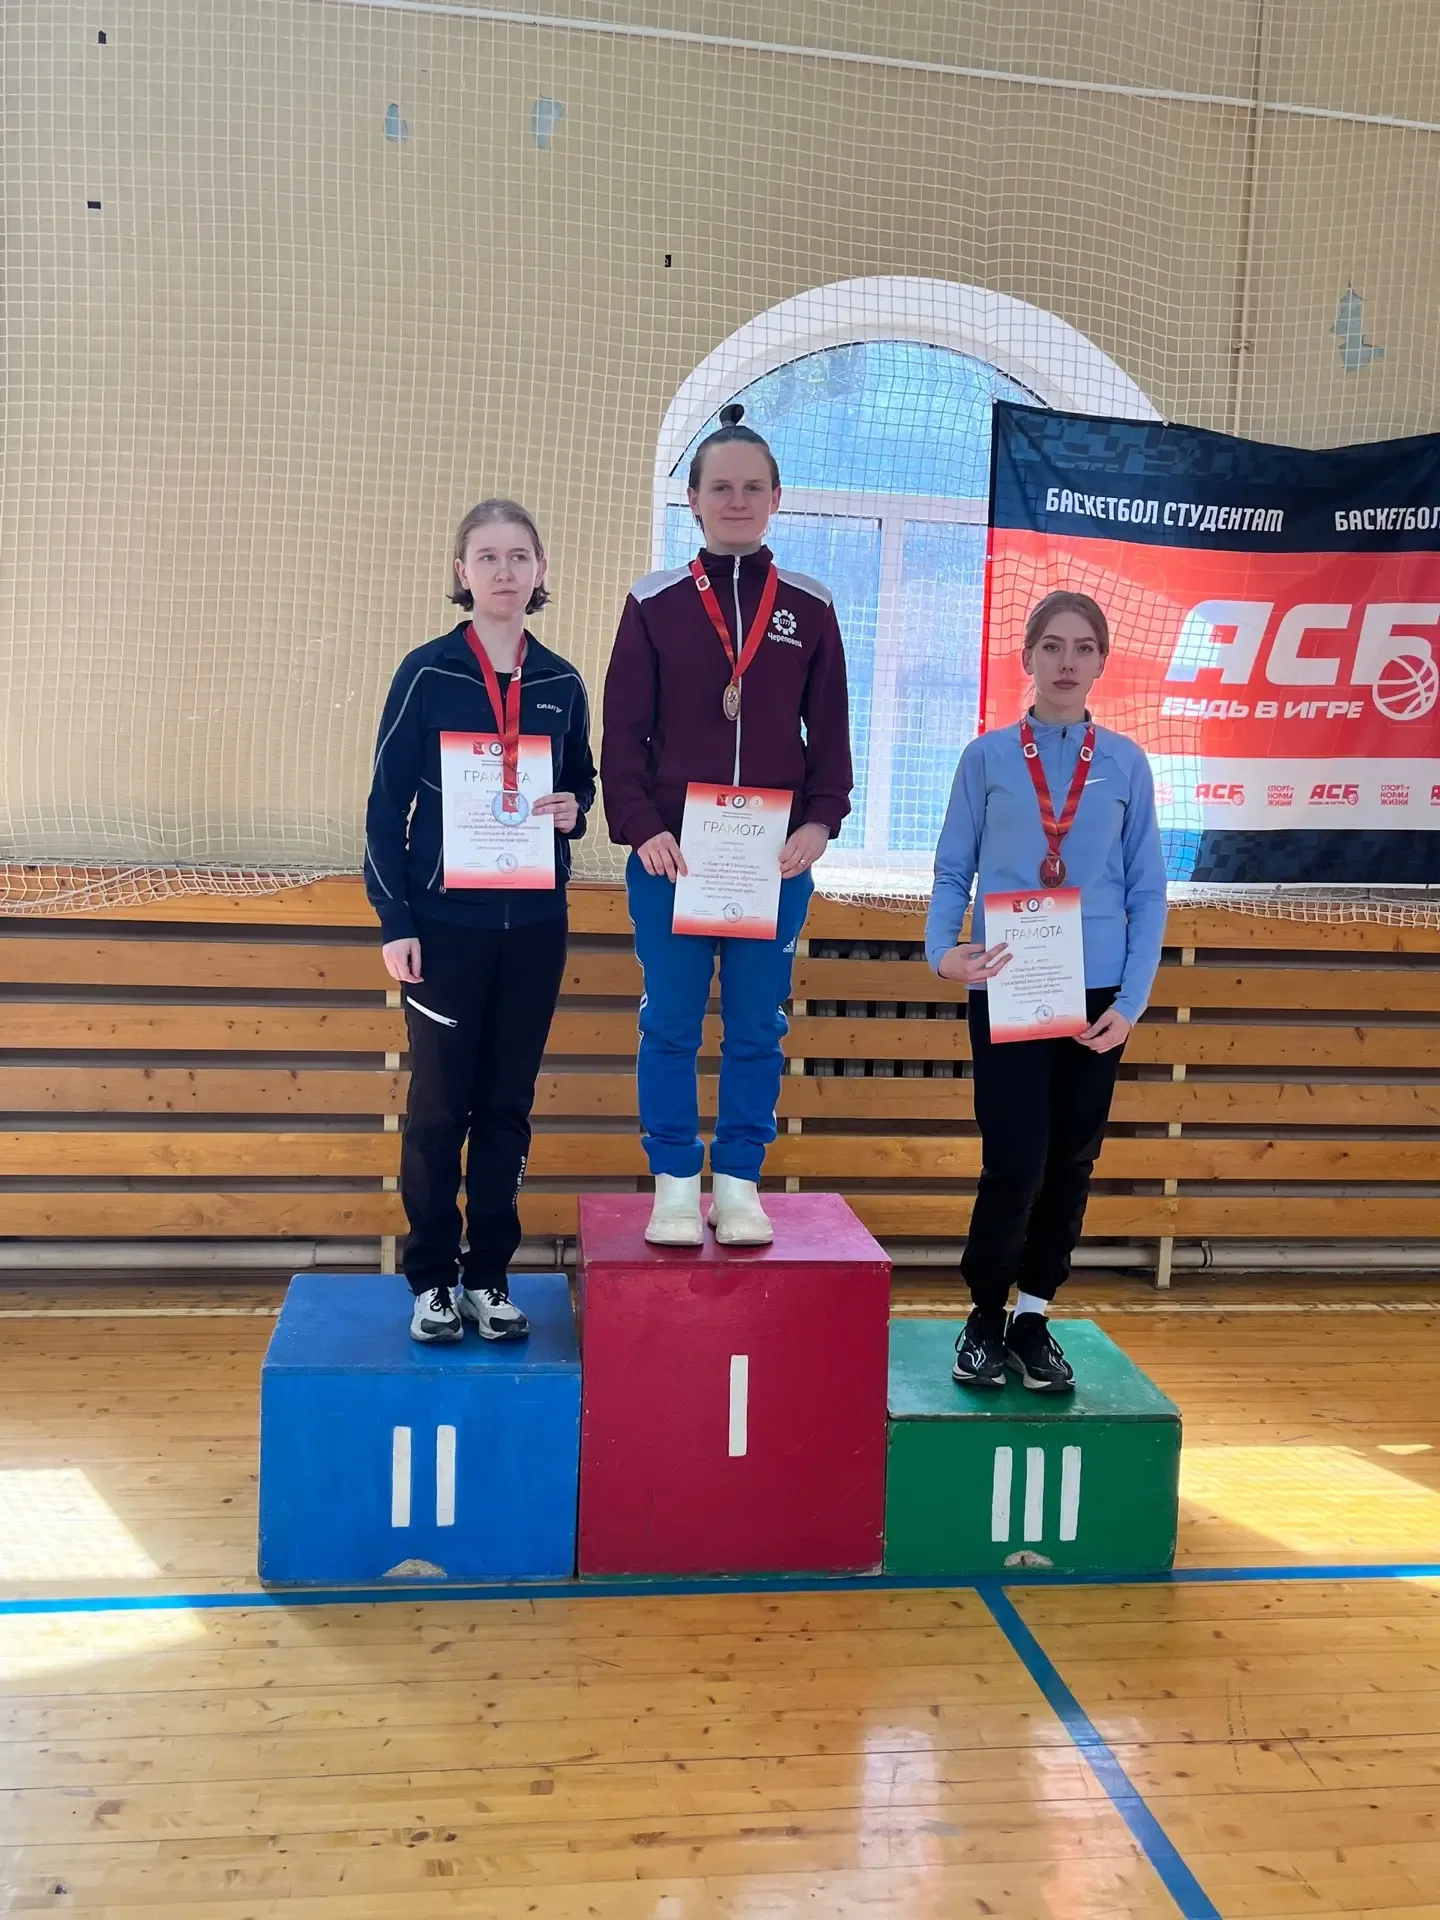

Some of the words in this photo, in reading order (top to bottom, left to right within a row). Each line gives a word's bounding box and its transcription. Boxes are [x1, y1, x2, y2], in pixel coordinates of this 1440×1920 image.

[1045, 487, 1158, 524] БАСКЕТБОЛ
[1163, 502, 1285, 533] СТУДЕНТАМ
[767, 631, 803, 648] Череповец
[1165, 599, 1440, 686] АСБ
[1161, 697, 1250, 720] БУДЬ
[1254, 701, 1278, 719] В
[1283, 701, 1364, 719] ИГРЕ
[463, 770, 532, 784] ГРАМТА
[1195, 783, 1244, 806] АСБ
[1310, 784, 1359, 805] АСБ
[1381, 784, 1405, 792] СПОРТ
[703, 820, 765, 837] ГРАМОТА
[1004, 925, 1064, 941] ГРАМОТА
[991, 1445, 1082, 1543] III
